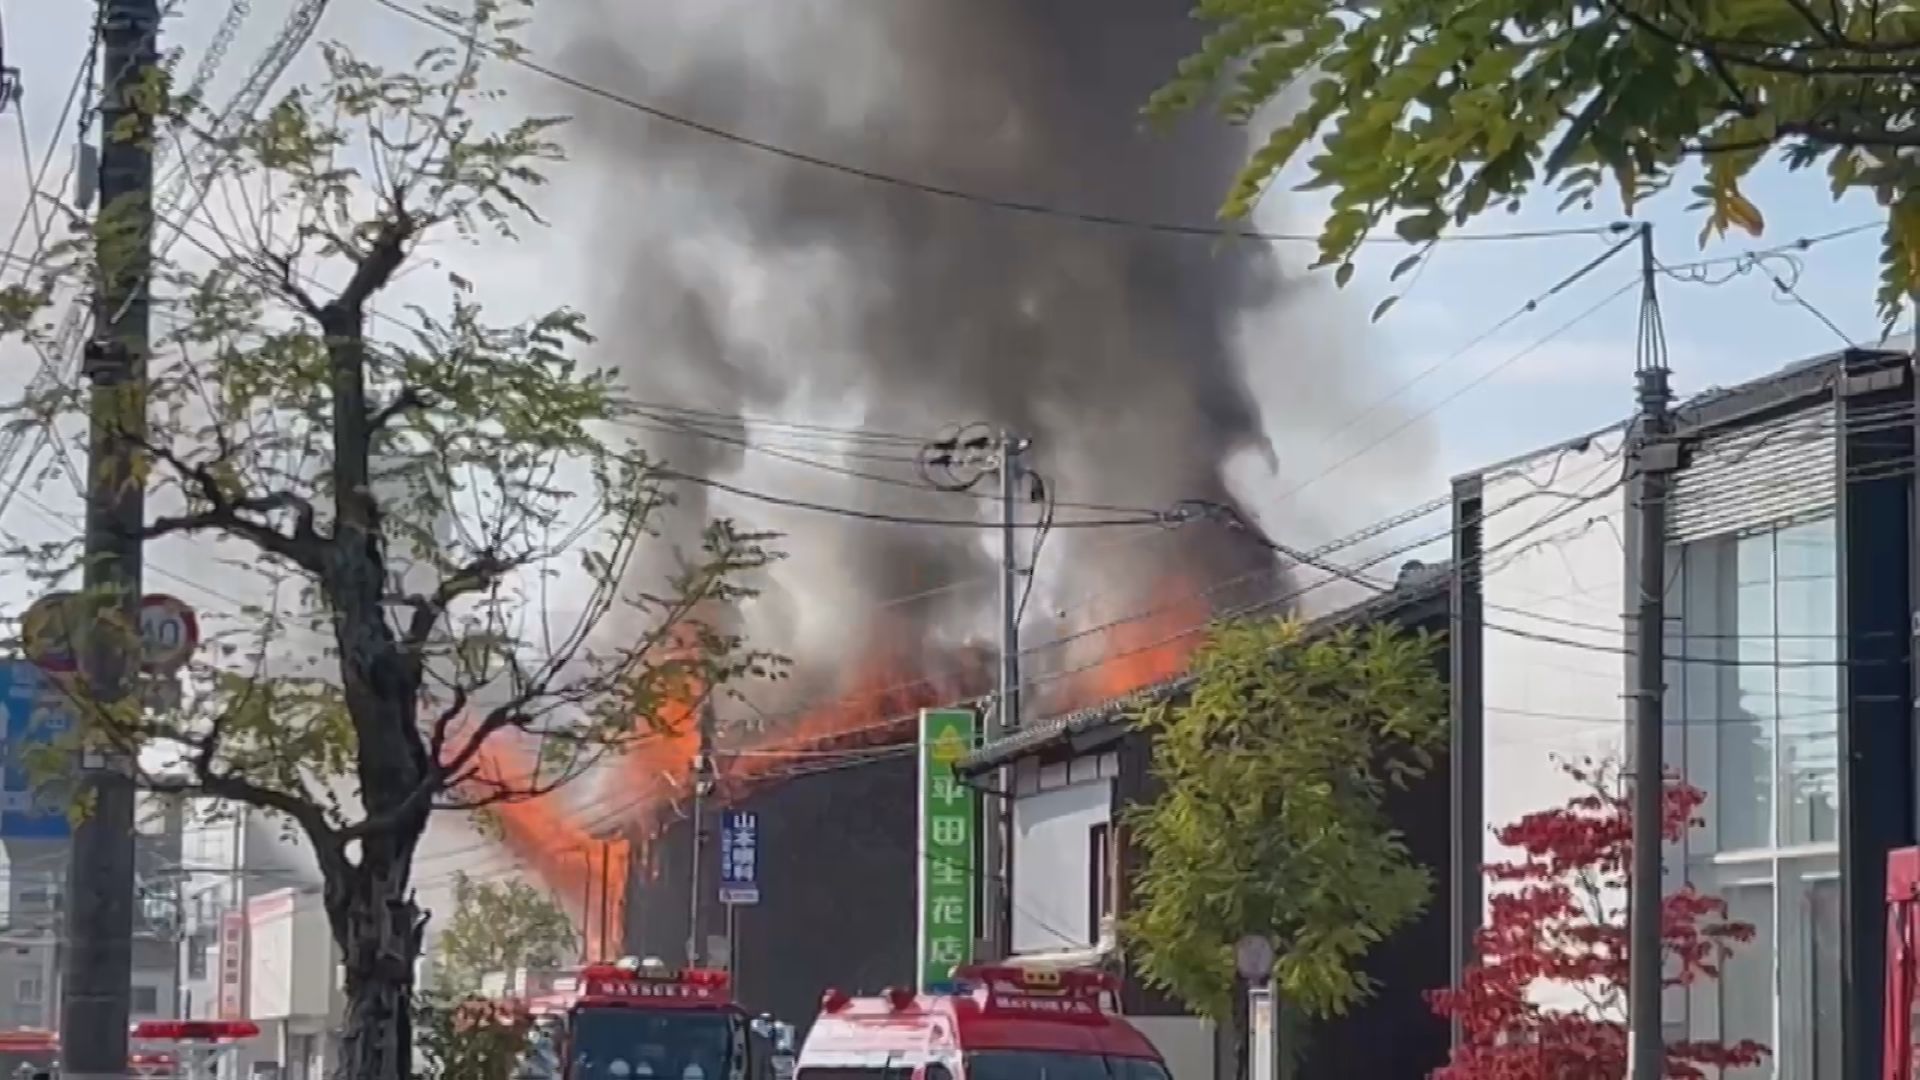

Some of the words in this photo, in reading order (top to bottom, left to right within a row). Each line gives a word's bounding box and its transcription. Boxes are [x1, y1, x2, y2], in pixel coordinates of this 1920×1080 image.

[931, 775, 965, 963] 平田生花店
